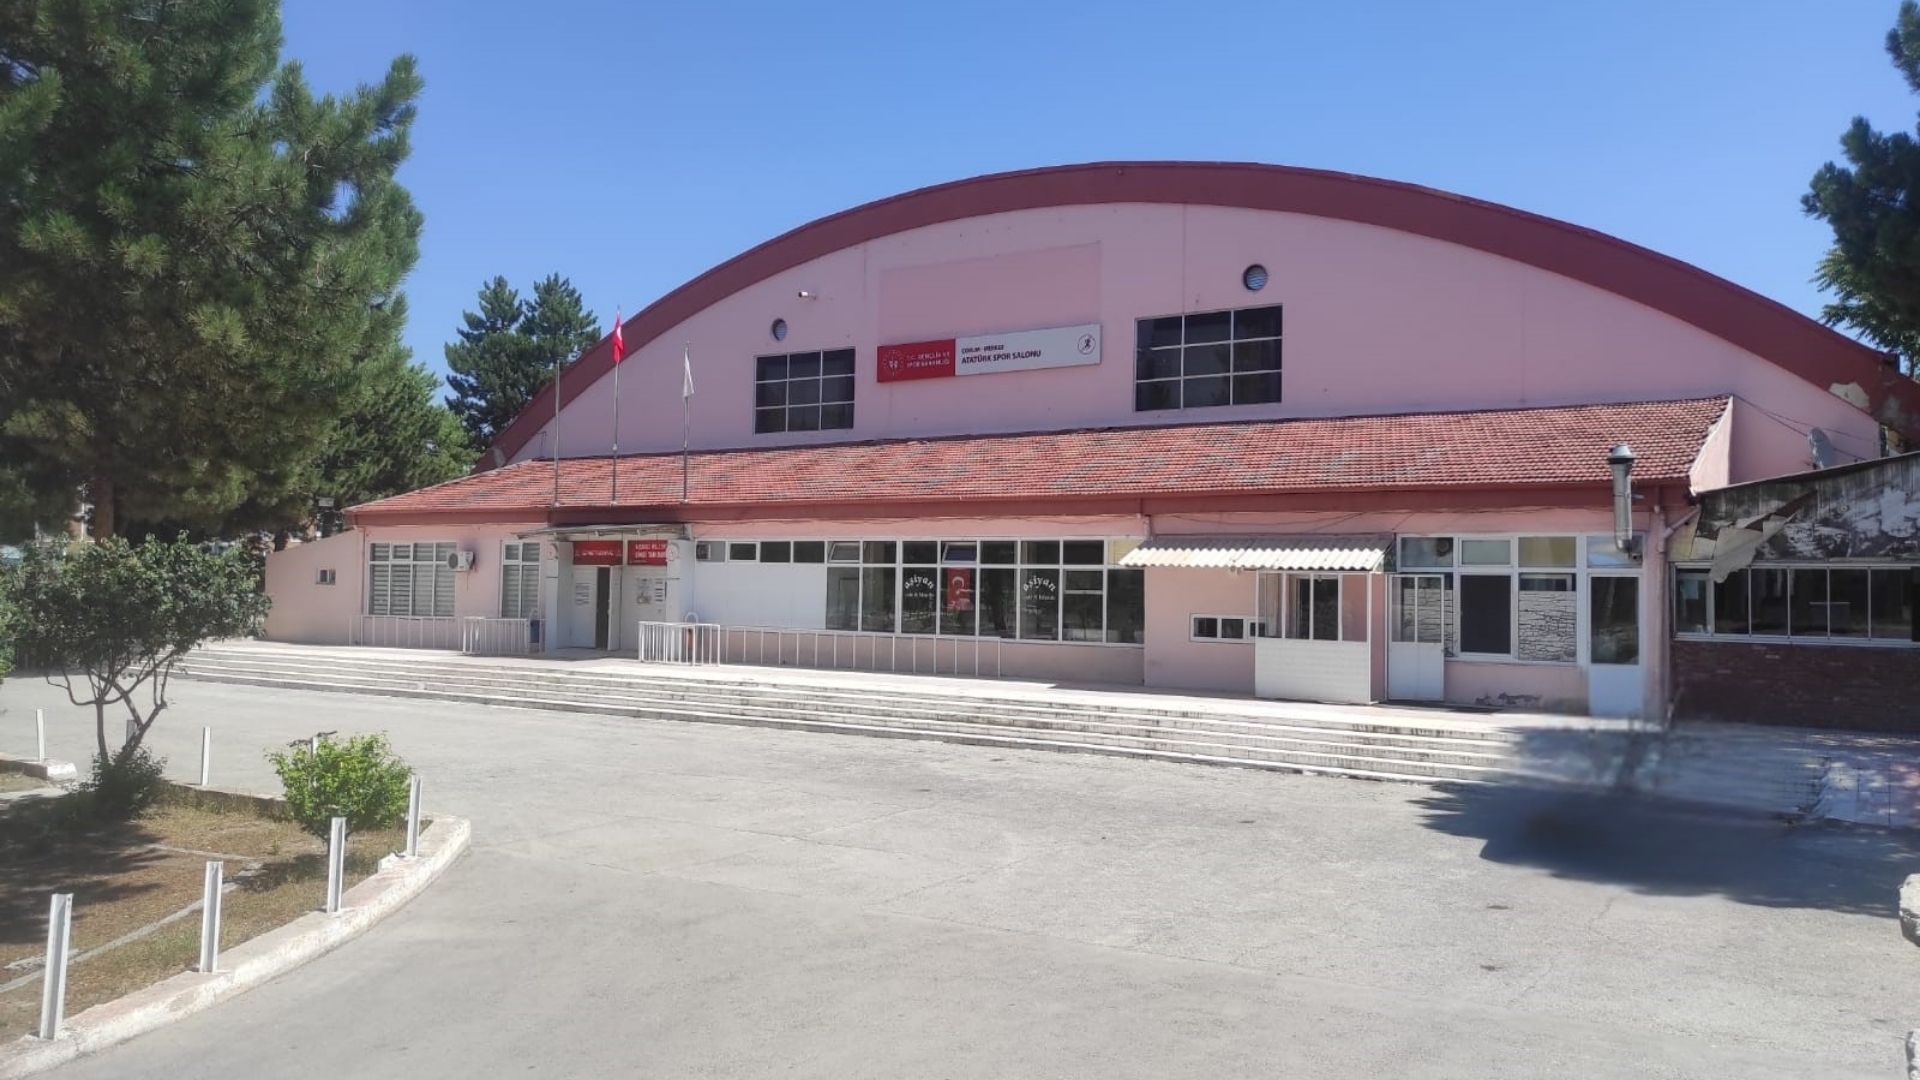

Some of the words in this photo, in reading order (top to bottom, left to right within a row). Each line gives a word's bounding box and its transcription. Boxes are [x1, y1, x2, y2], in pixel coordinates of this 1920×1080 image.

[961, 354, 991, 364] ATATÜRK
[993, 353, 1011, 361] SPOR
[1013, 350, 1041, 360] SALONU
